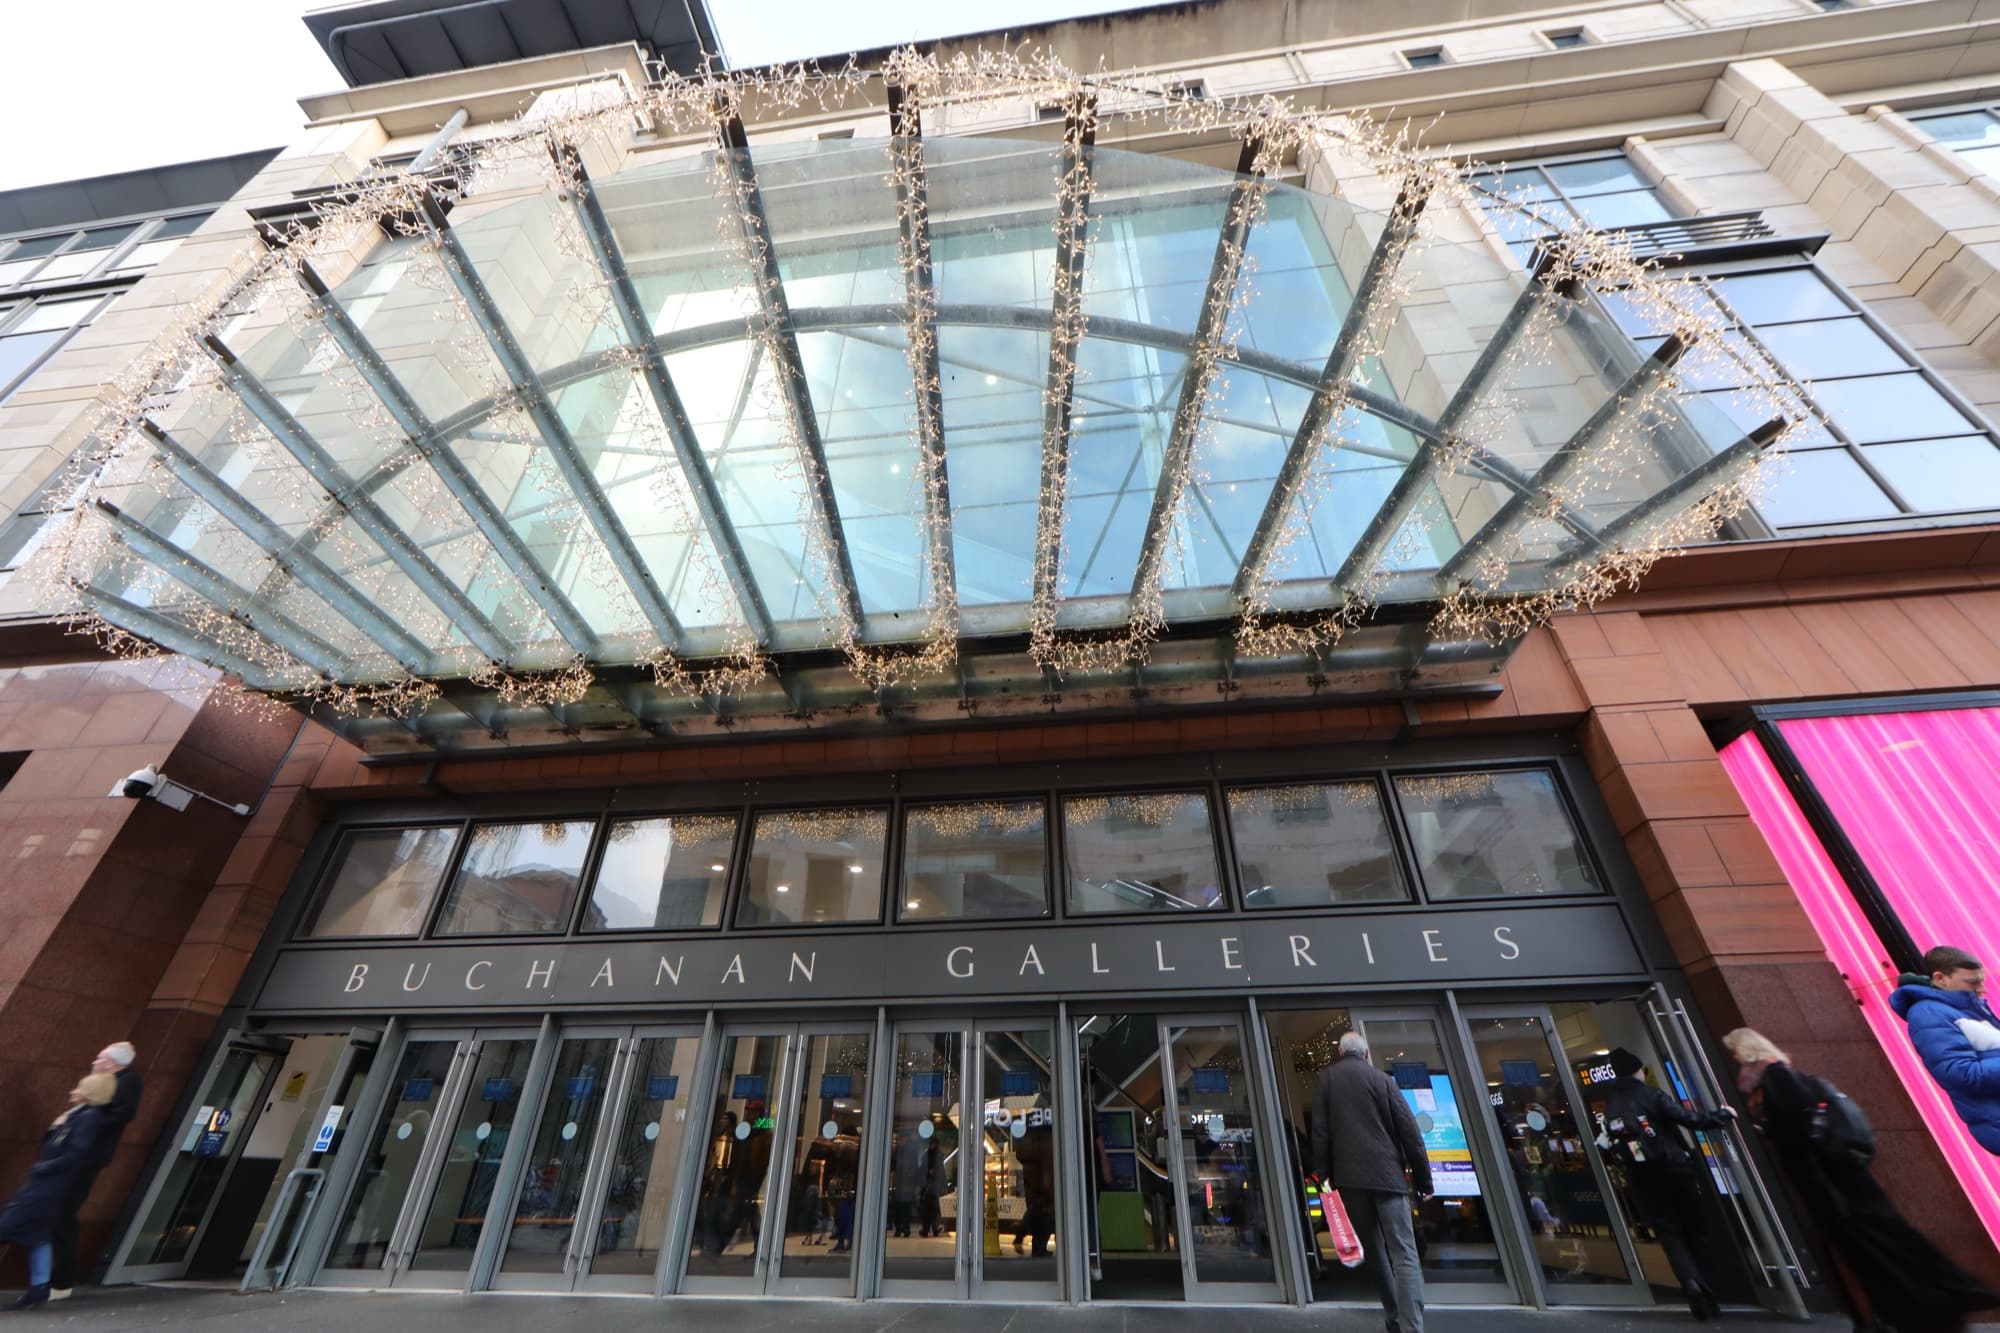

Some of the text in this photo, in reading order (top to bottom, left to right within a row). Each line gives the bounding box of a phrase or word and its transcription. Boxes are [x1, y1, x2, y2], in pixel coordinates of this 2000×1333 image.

[343, 926, 1520, 993] BUCHANAN GALLERIES
[1589, 1063, 1616, 1084] GREG
